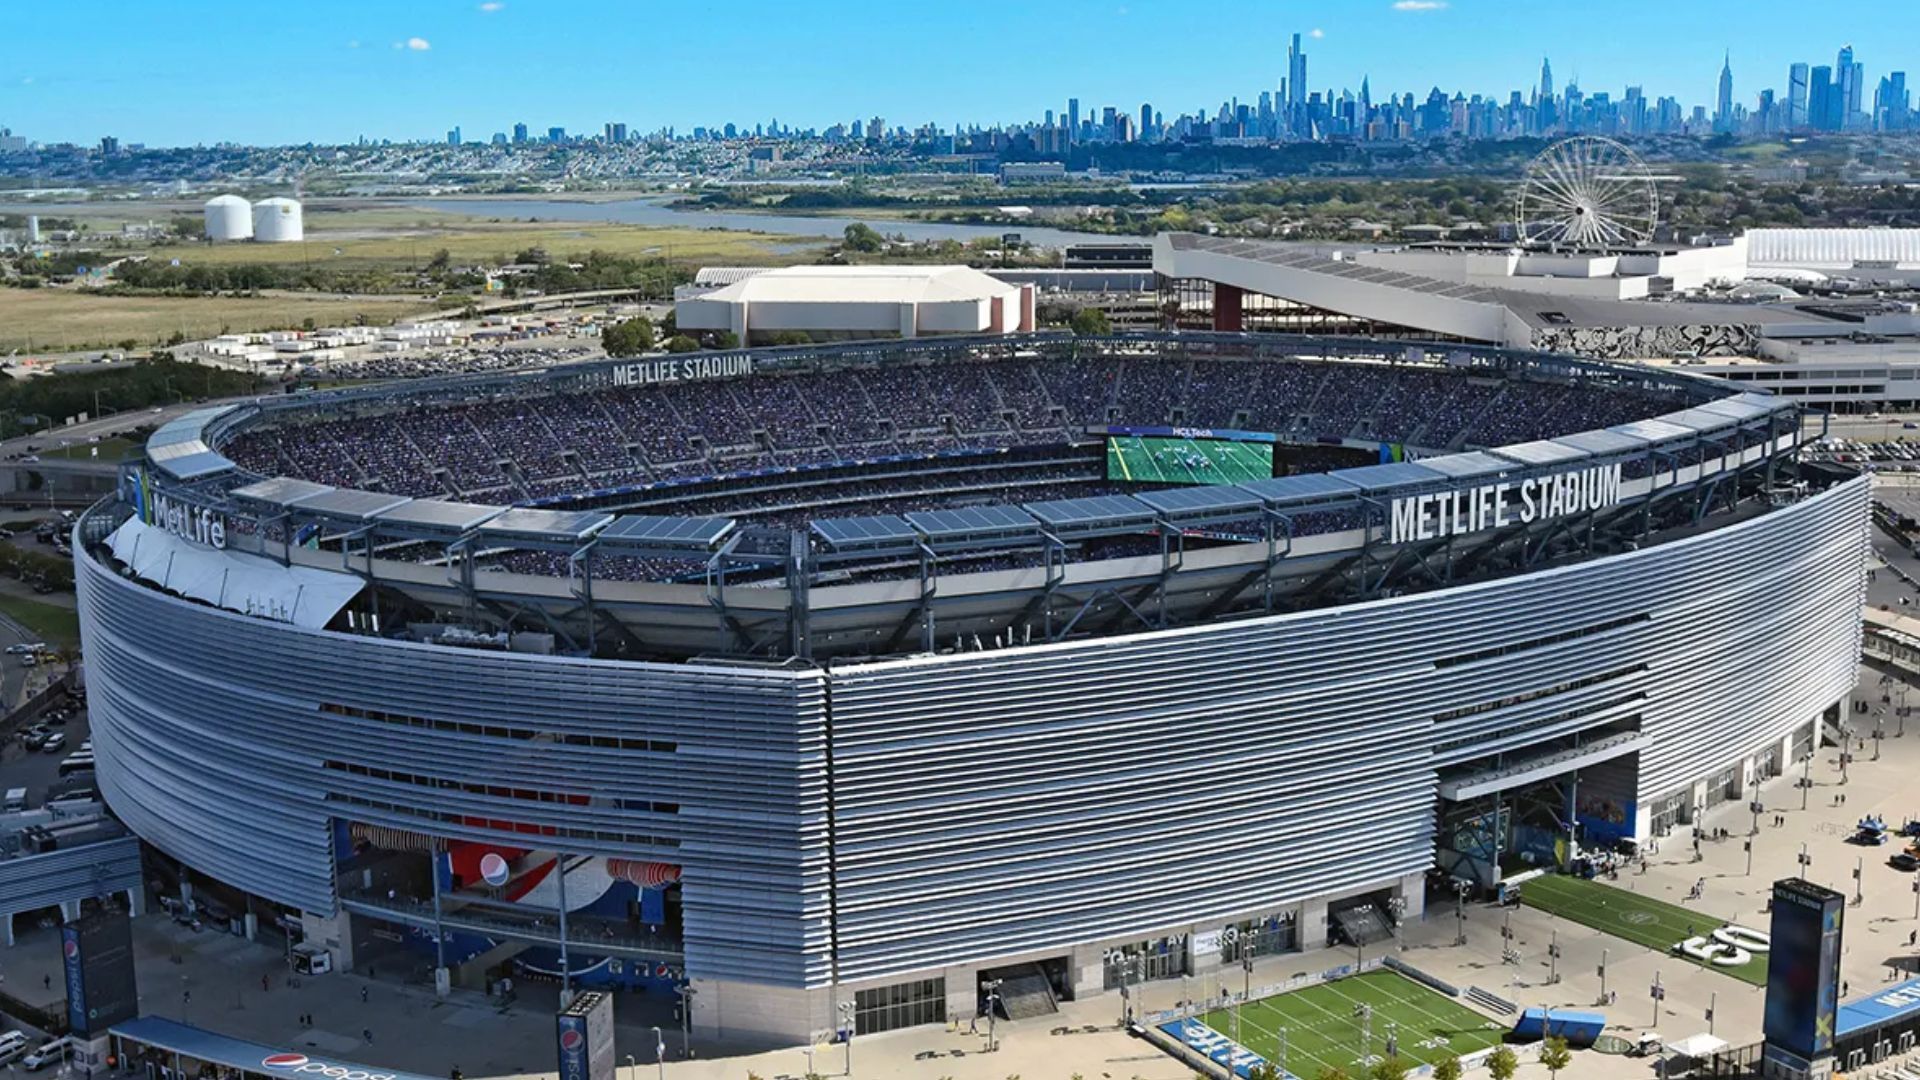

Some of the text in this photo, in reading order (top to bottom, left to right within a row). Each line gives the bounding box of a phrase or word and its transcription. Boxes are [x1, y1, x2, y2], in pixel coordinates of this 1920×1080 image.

[613, 355, 751, 386] METLIFE STADIUM
[1172, 427, 1213, 438] HCLTech
[153, 492, 227, 549] MetLife
[1391, 463, 1622, 545] METLIFE STADIUM
